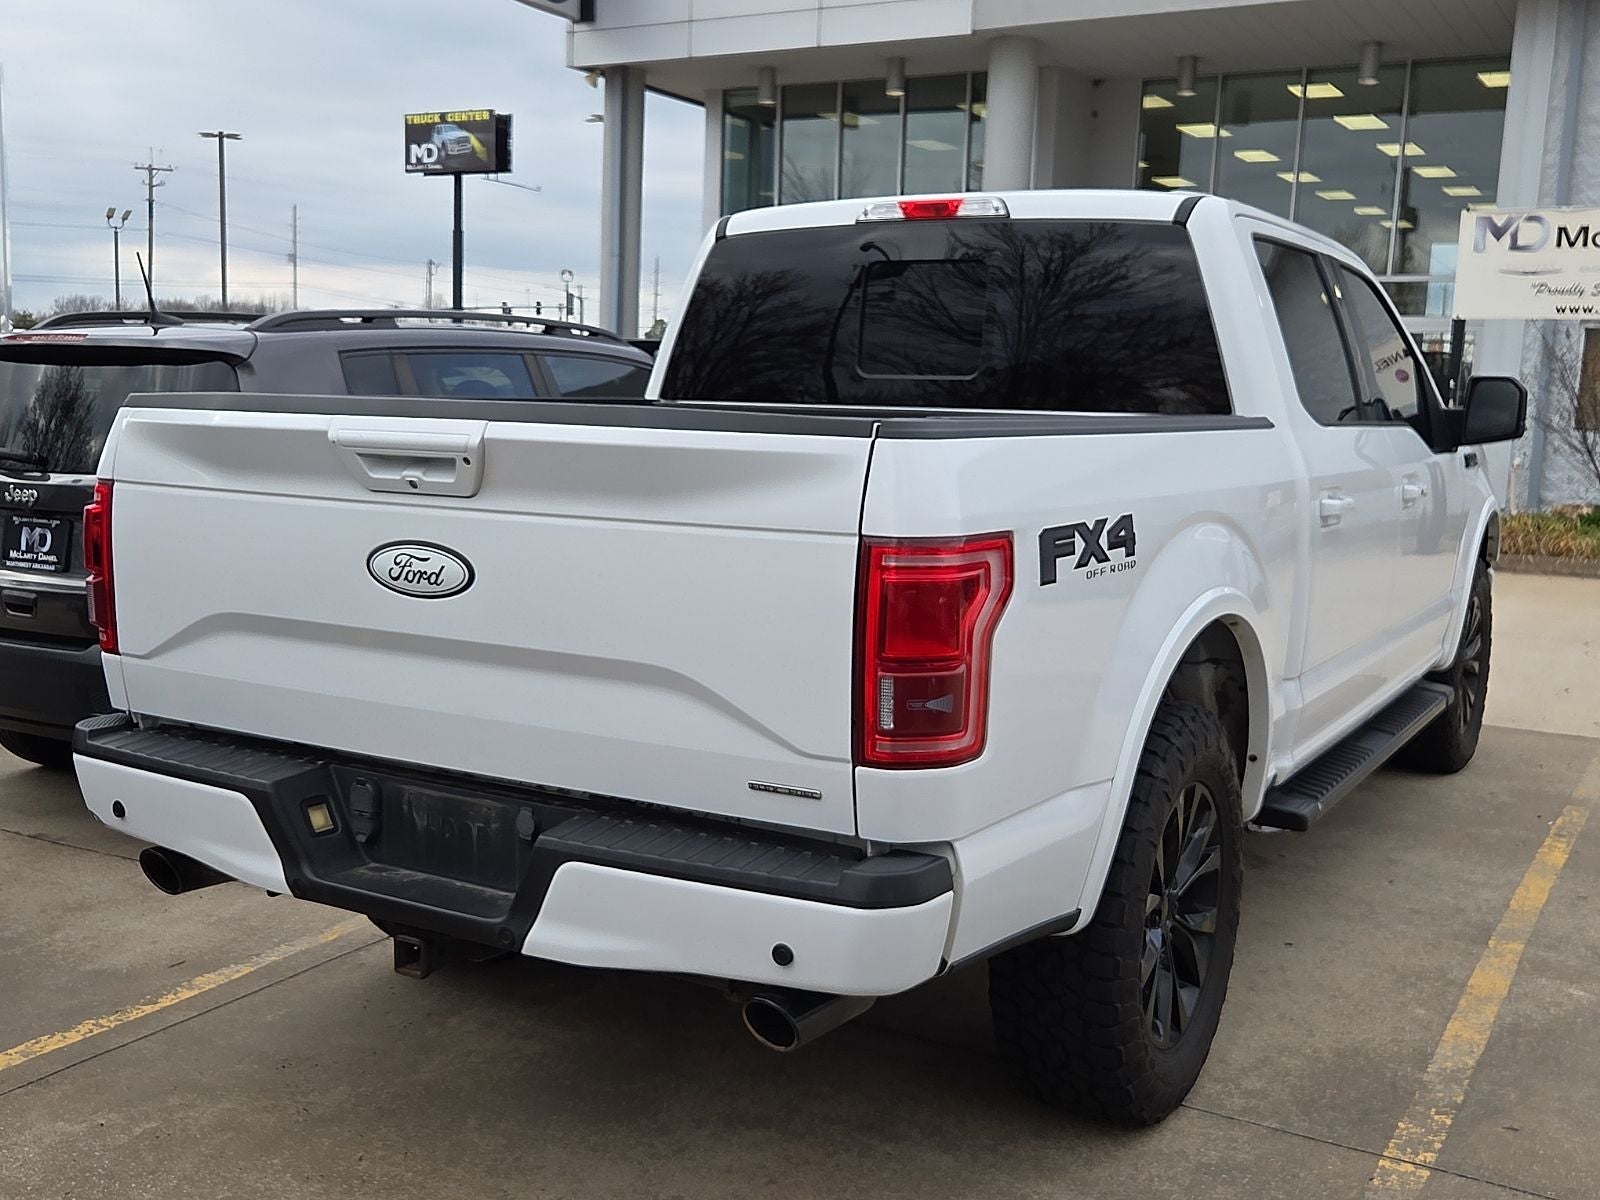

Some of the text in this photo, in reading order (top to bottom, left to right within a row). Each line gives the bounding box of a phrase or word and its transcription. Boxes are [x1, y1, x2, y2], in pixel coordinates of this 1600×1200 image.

[406, 111, 490, 125] TRUCK CENTER
[409, 143, 438, 164] MD
[1473, 213, 1551, 254] MD
[4, 484, 38, 506] Jeep
[20, 525, 52, 553] MD
[1038, 513, 1137, 586] FX4
[388, 552, 446, 586] Ford
[1086, 559, 1137, 580] OFF ROAD
